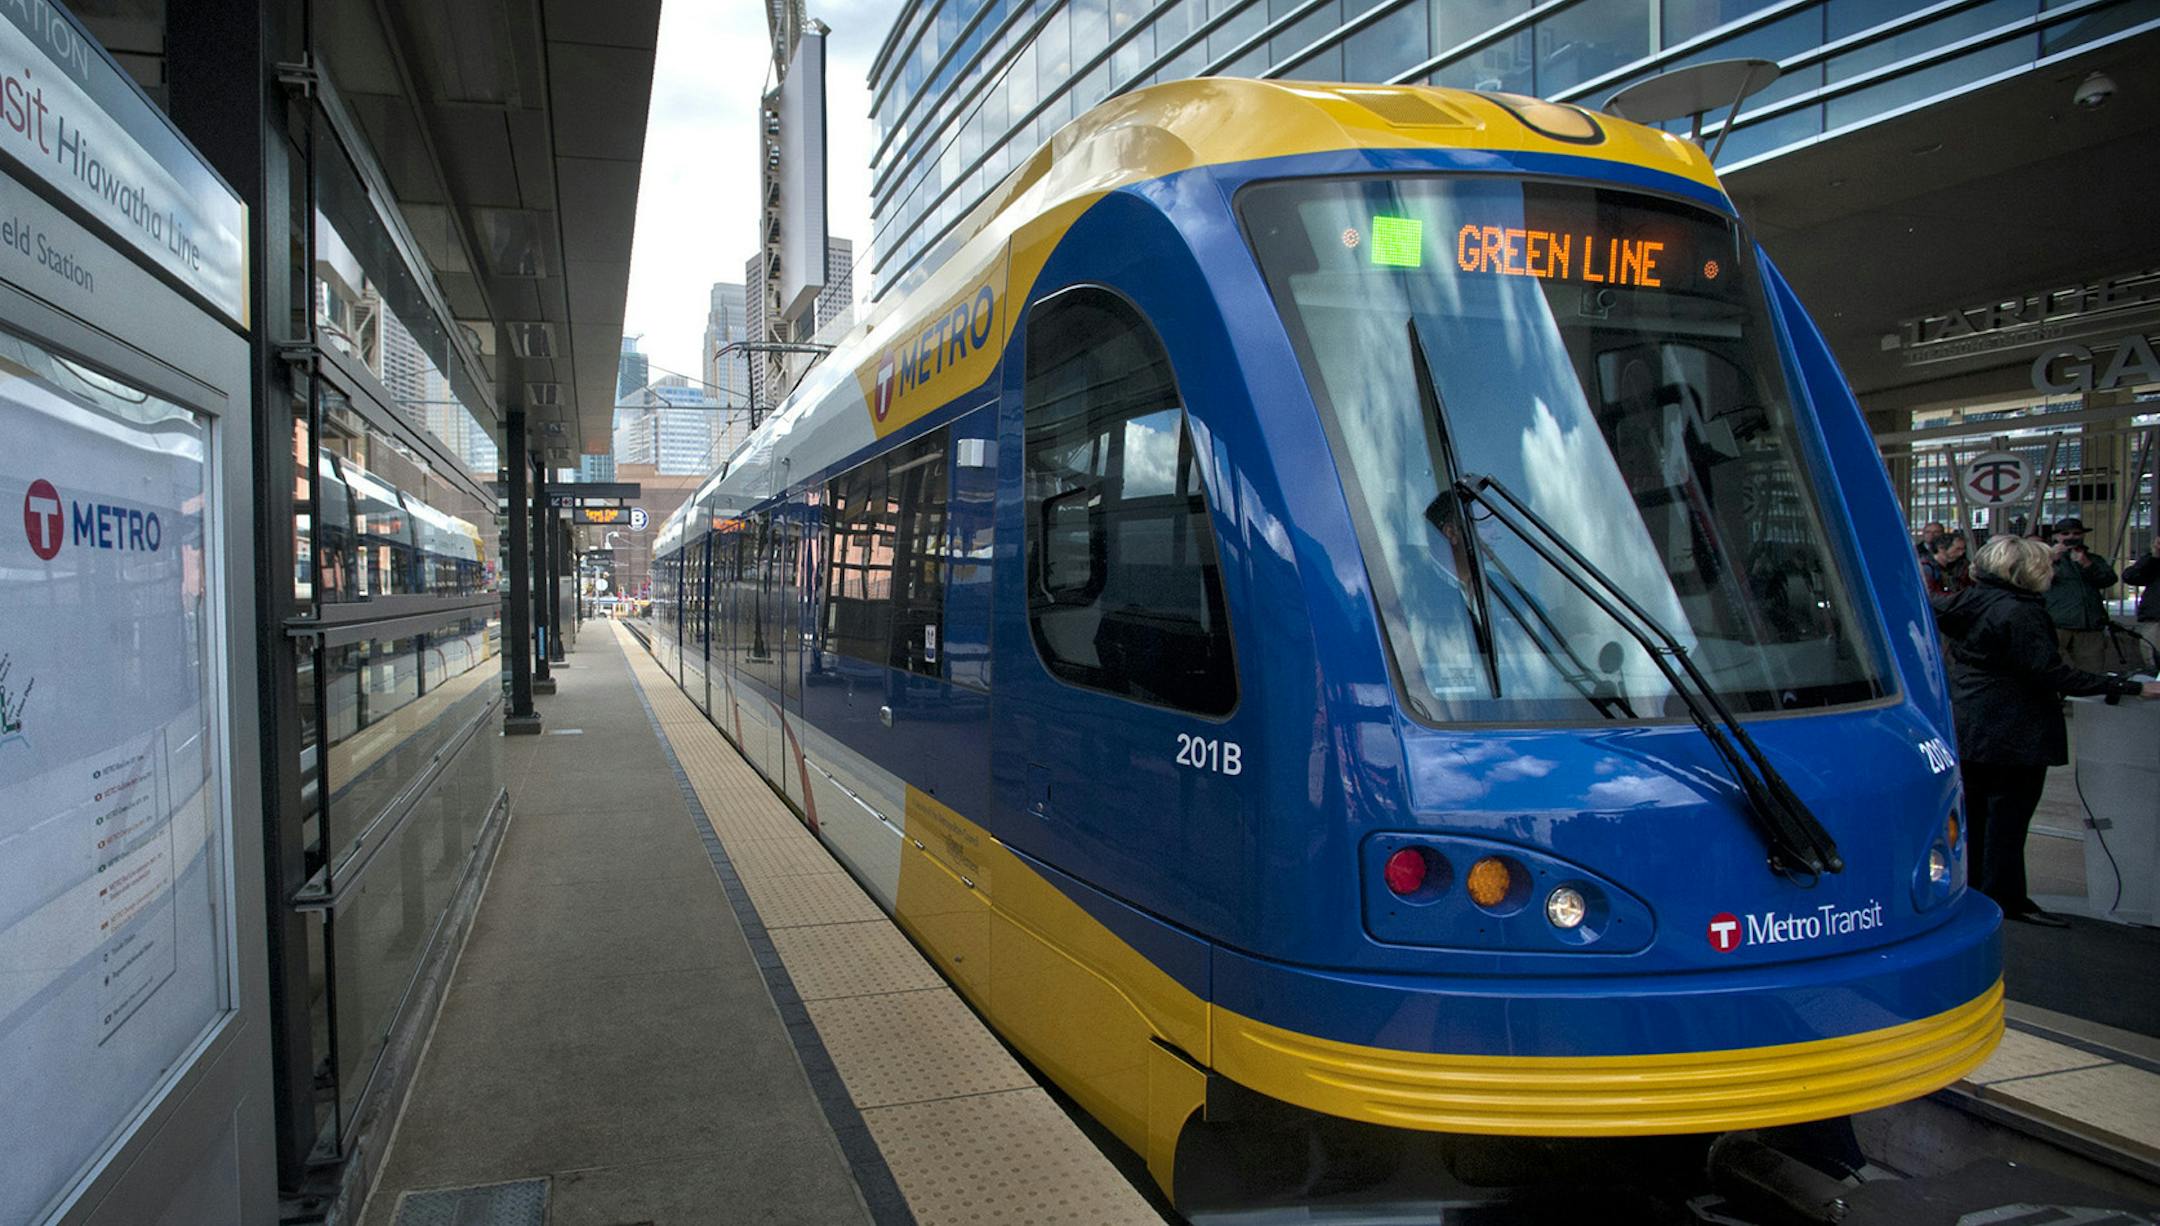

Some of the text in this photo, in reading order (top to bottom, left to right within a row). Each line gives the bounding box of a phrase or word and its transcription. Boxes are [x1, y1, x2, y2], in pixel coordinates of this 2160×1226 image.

[57, 116, 162, 238] Hiawatha
[168, 212, 200, 272] Line
[37, 232, 94, 293] Station
[1457, 224, 1665, 288] GREEN LINE
[899, 284, 994, 397] METRO
[72, 500, 161, 552] METRO
[1176, 733, 1242, 776] 201B
